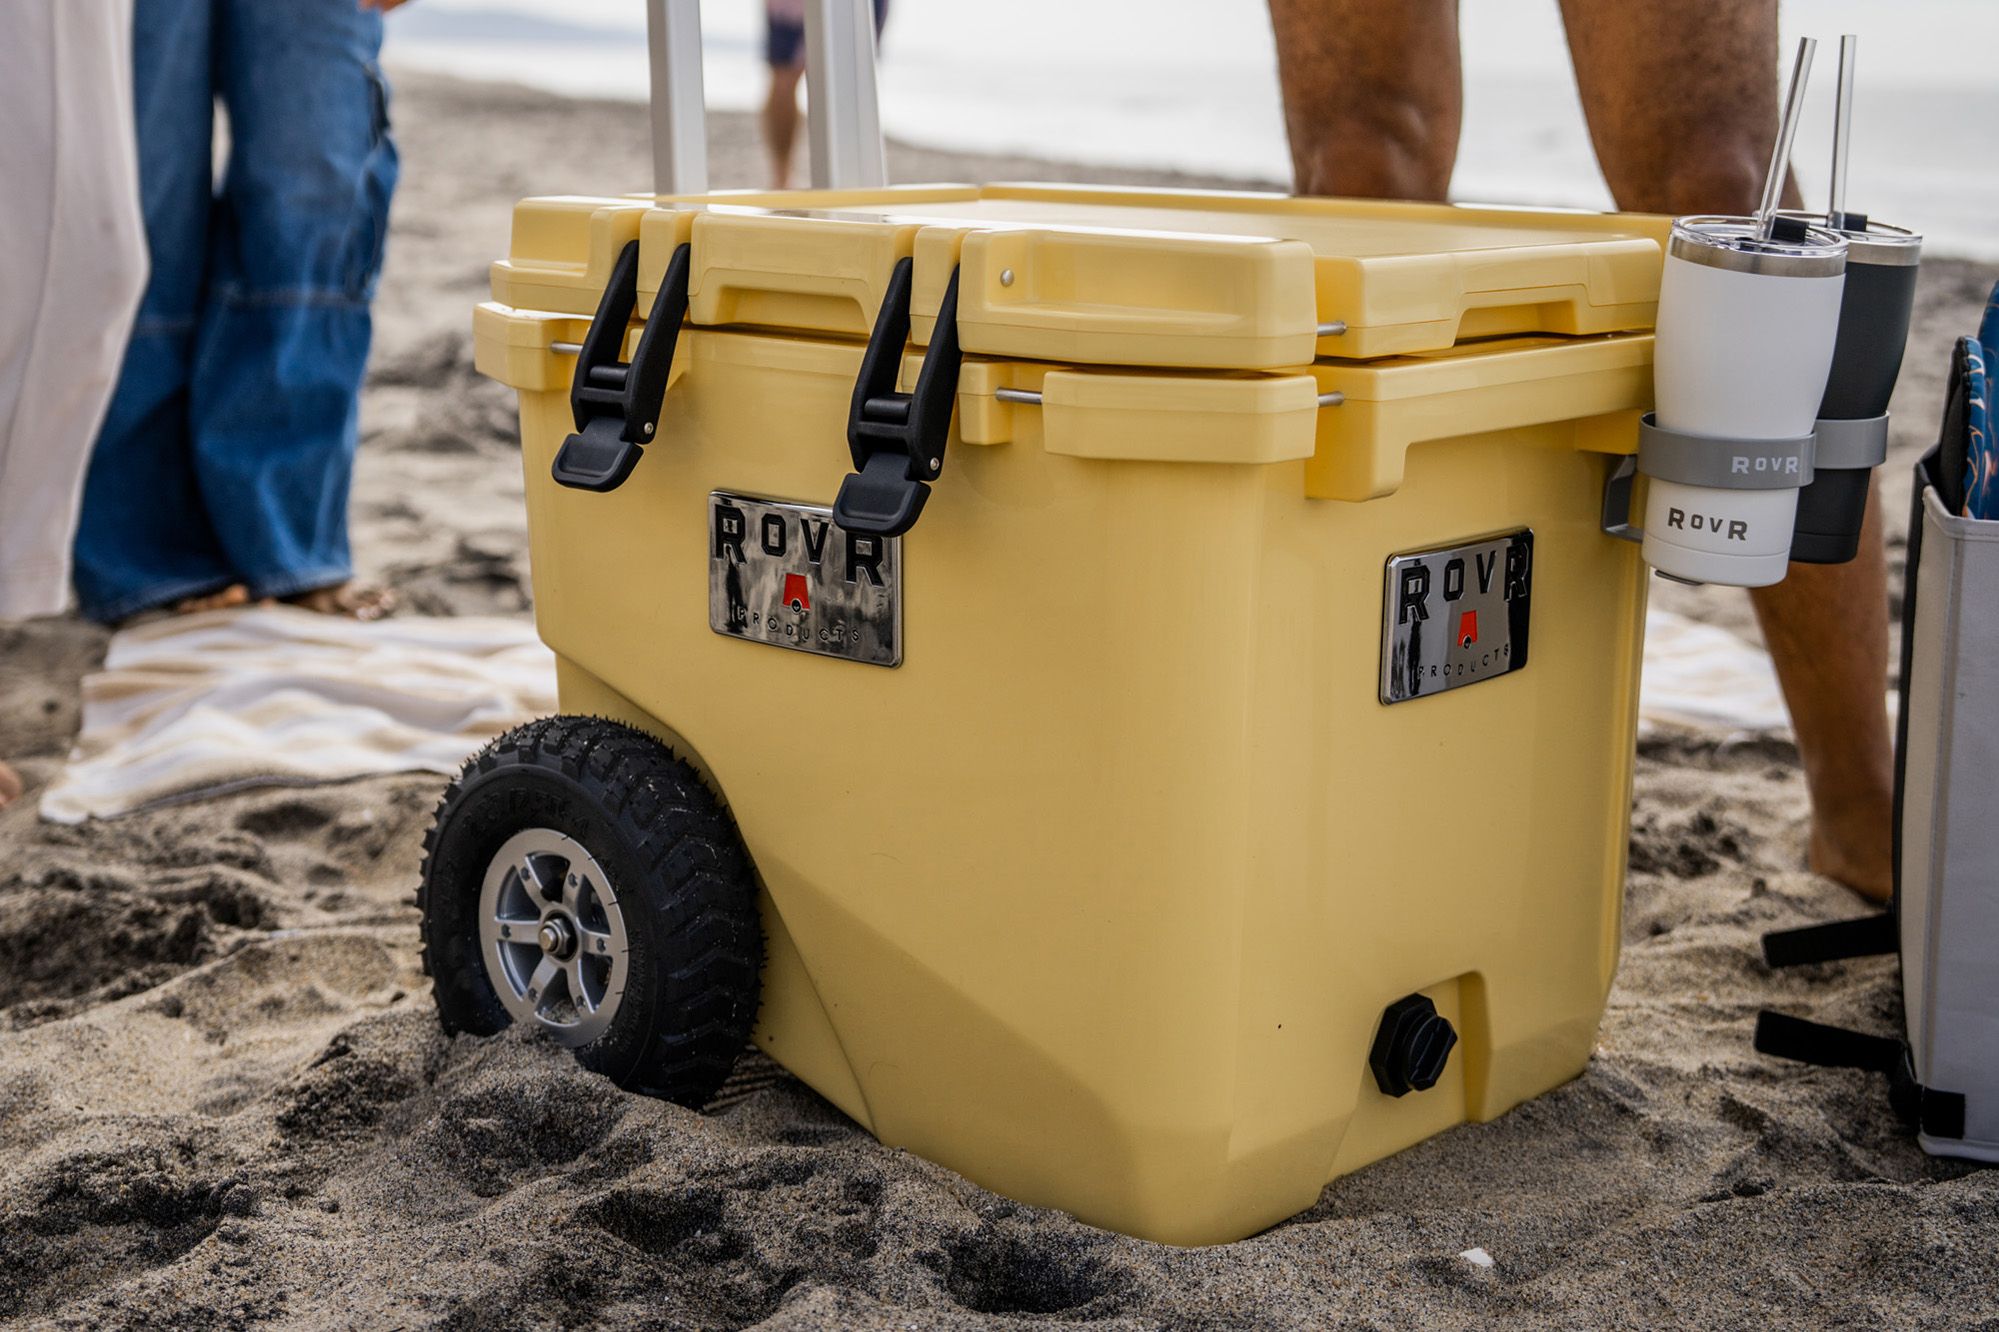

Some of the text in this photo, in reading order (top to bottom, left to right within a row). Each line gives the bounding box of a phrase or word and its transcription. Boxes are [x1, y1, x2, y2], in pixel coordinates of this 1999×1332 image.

[1731, 456, 1799, 474] ROVR
[1667, 507, 1748, 541] ROVR
[715, 504, 885, 587] ROVR
[1399, 543, 1529, 625] ROVR
[737, 606, 860, 642] PRODUCTS
[1417, 643, 1510, 680] PRODUCTS
